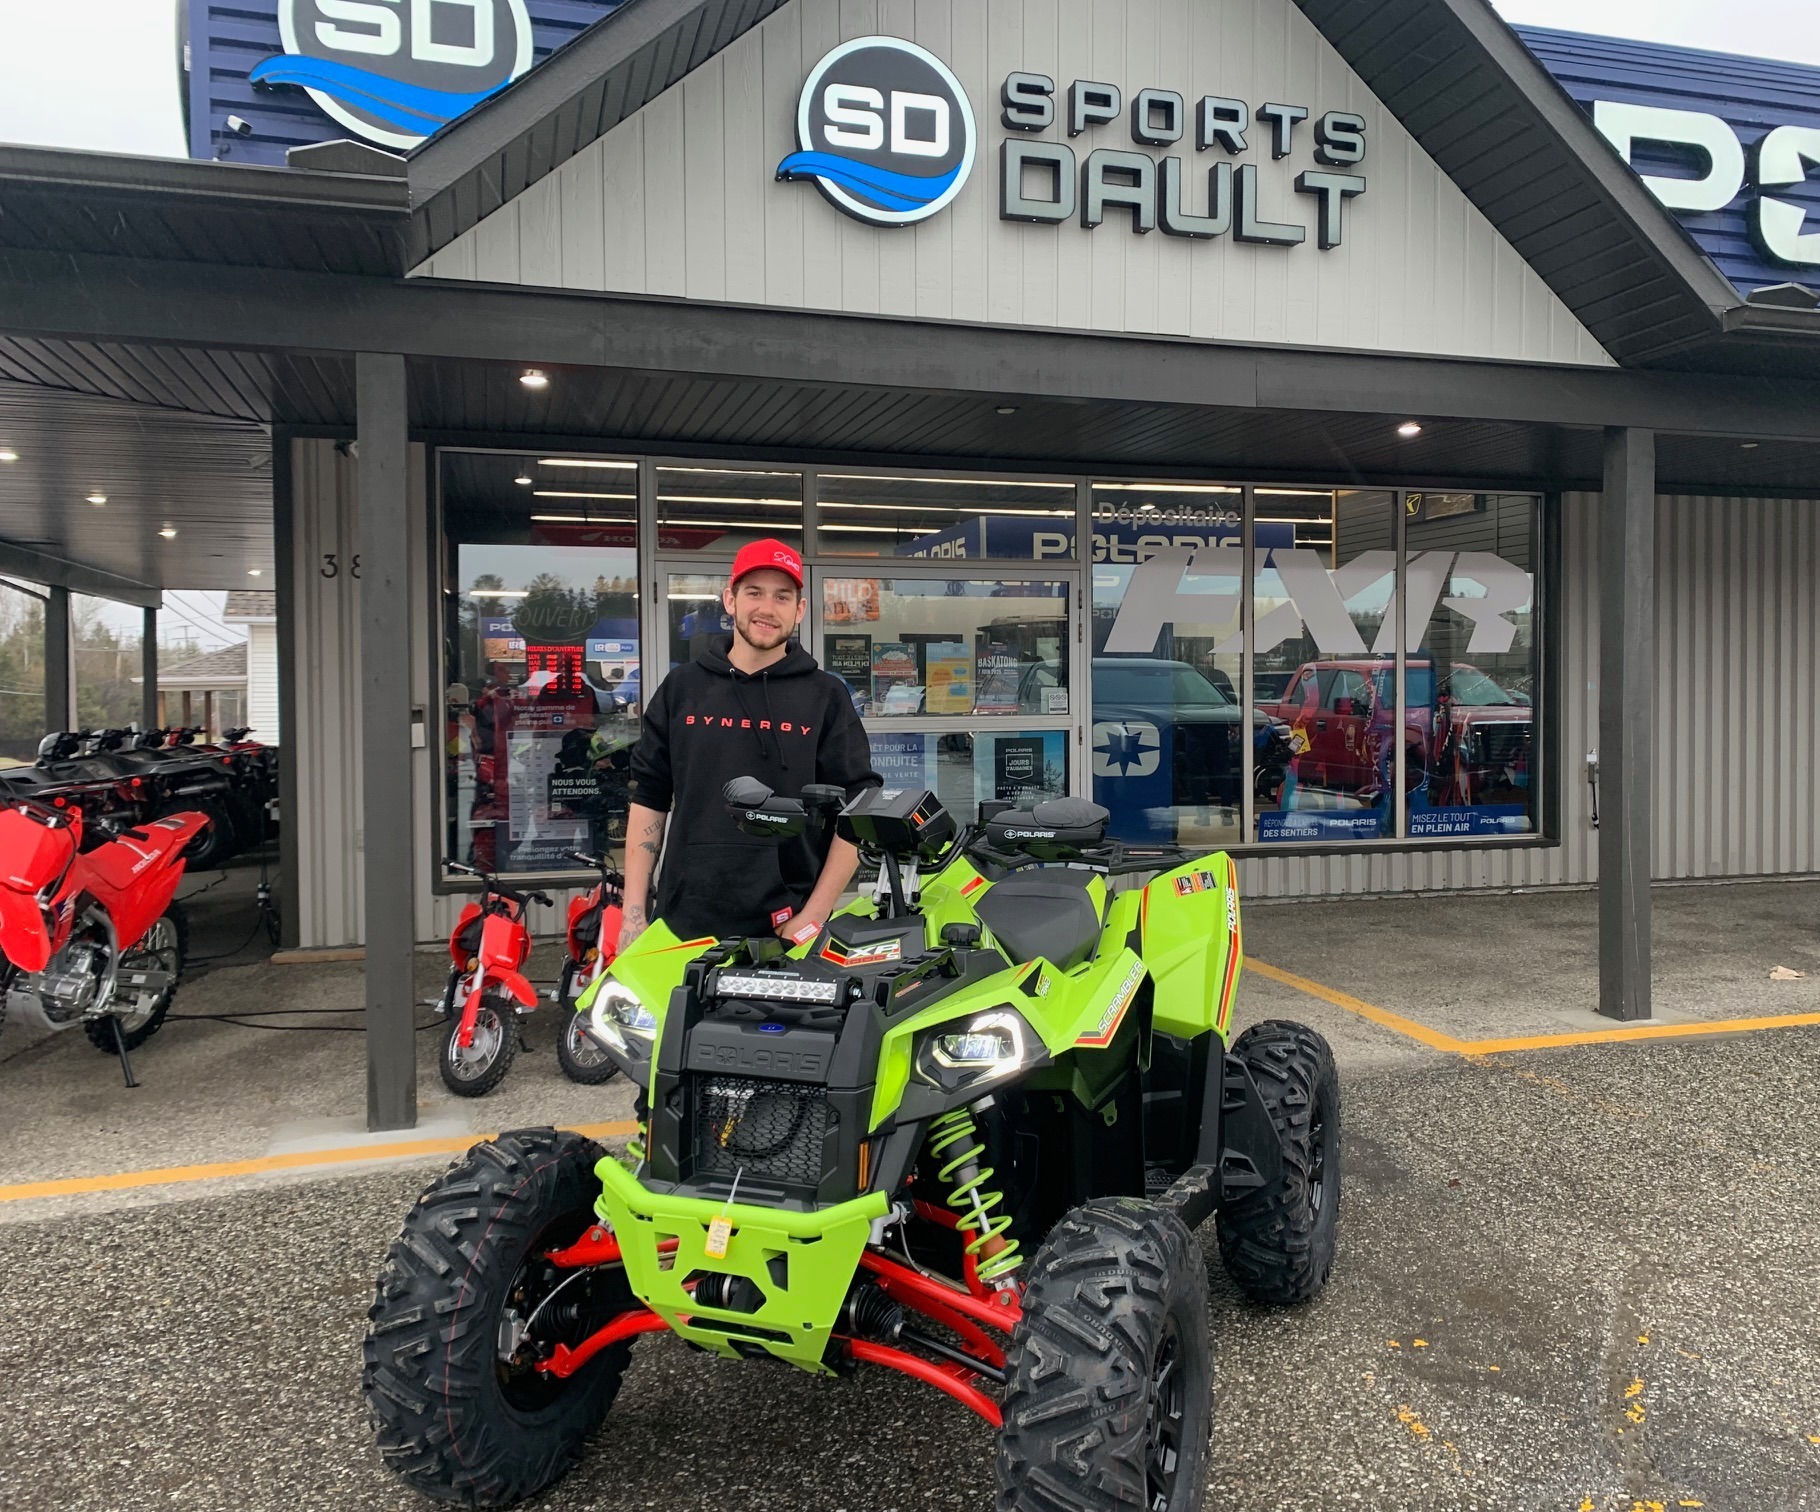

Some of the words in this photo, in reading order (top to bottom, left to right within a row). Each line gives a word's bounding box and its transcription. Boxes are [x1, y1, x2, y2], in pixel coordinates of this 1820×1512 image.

[823, 83, 950, 158] SD
[1001, 71, 1367, 166] SPORTS
[1000, 138, 1367, 249] DAULT
[1098, 501, 1239, 531] Dépositaire
[1102, 545, 1533, 653] FXR
[977, 655, 1018, 667] BASKATONG
[685, 715, 811, 735] SYNERGY
[884, 744, 906, 752] POUR
[906, 743, 918, 751] LA
[870, 756, 919, 767] ONDUITE
[575, 778, 597, 786] VOUS
[552, 787, 602, 796] ATTENDONS.
[756, 813, 788, 824] POLARIS
[1329, 818, 1377, 827] POLARIS
[1412, 814, 1436, 823] MISEZ
[1437, 813, 1448, 822] LE
[1450, 812, 1471, 822] TOUT
[1263, 829, 1279, 838] DES
[1280, 828, 1318, 837] SENTIERS
[1411, 825, 1424, 834] EN
[1425, 824, 1452, 833] PLEIN
[1453, 823, 1470, 832] AIR
[1226, 885, 1237, 934] POLARIS
[776, 912, 789, 924] S
[848, 943, 899, 959] XP
[1098, 960, 1144, 1034] SCRAMBLER
[695, 1043, 822, 1074] POLARIS
